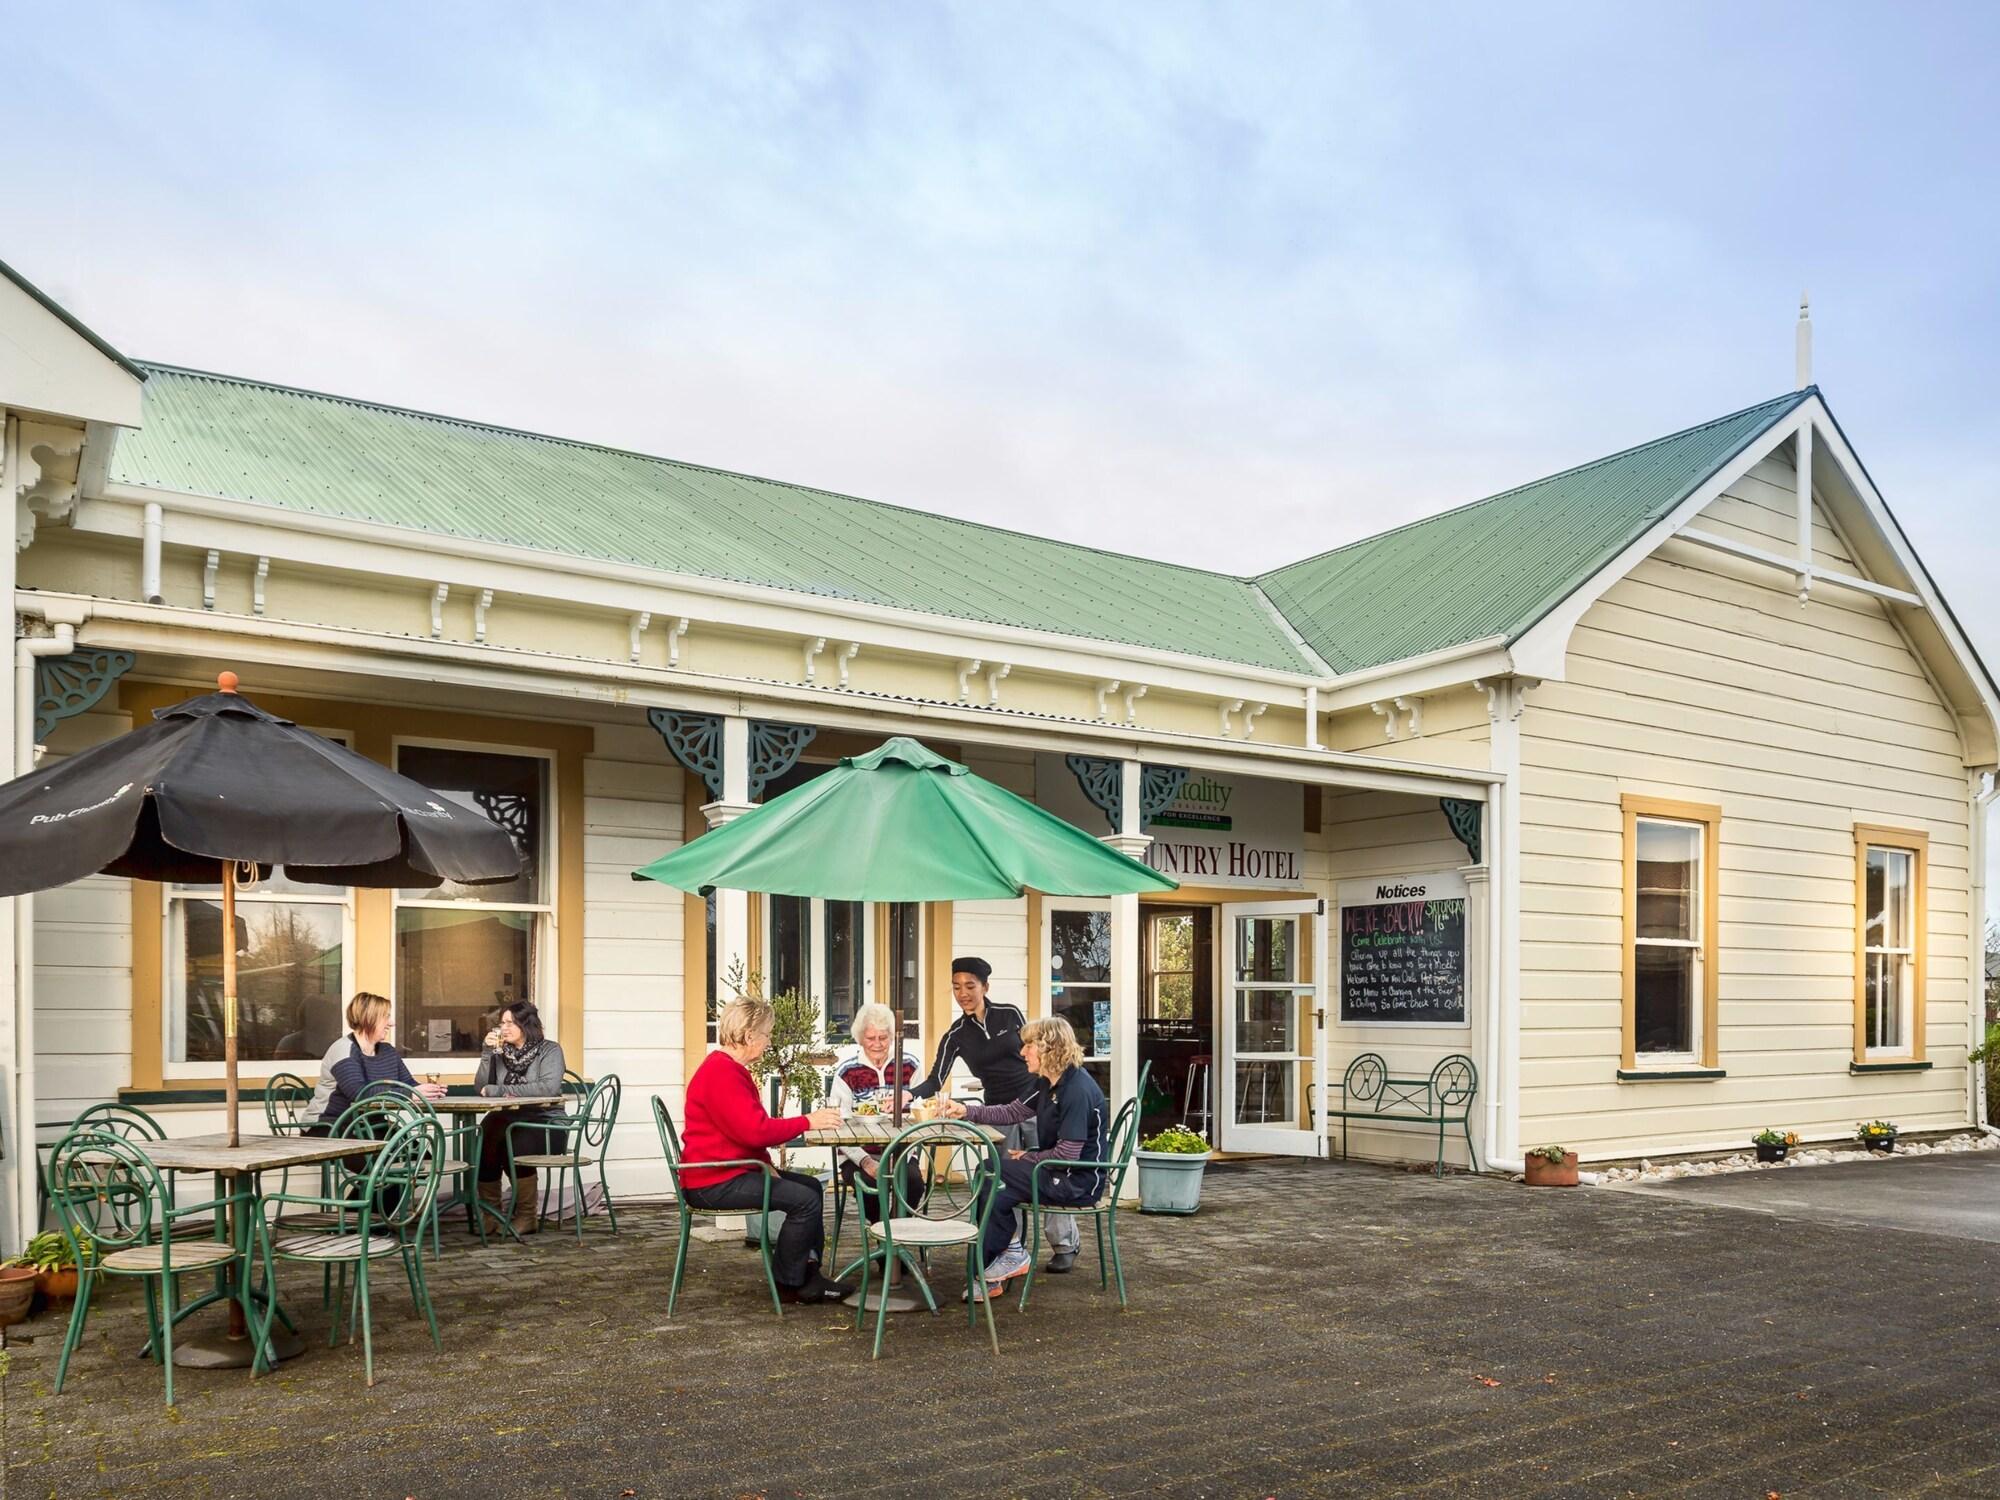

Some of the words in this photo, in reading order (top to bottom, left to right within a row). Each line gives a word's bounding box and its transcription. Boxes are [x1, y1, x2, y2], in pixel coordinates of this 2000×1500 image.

[30, 813, 67, 825] Pub
[1179, 813, 1221, 822] EXCELLENCE
[1228, 842, 1300, 880] HOTEL
[1376, 884, 1426, 899] Notices
[1393, 947, 1402, 958] all
